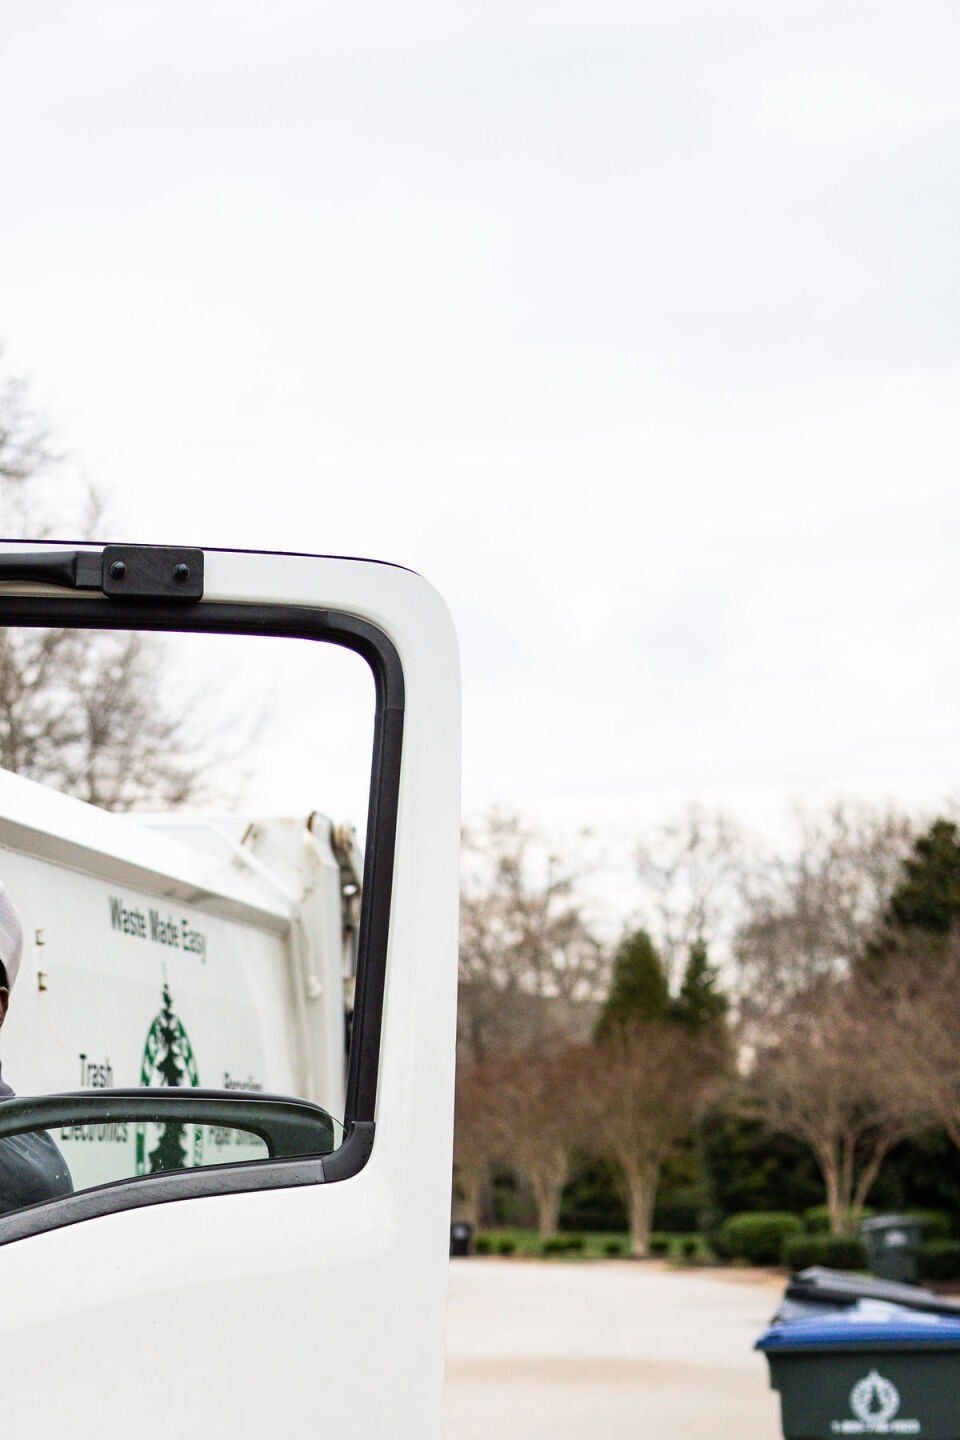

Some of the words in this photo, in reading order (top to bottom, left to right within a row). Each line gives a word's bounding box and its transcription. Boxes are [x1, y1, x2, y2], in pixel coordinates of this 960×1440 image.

[108, 895, 146, 938] Waste
[149, 908, 179, 948] Made
[182, 918, 207, 963] Easy
[79, 1053, 113, 1088] Trash
